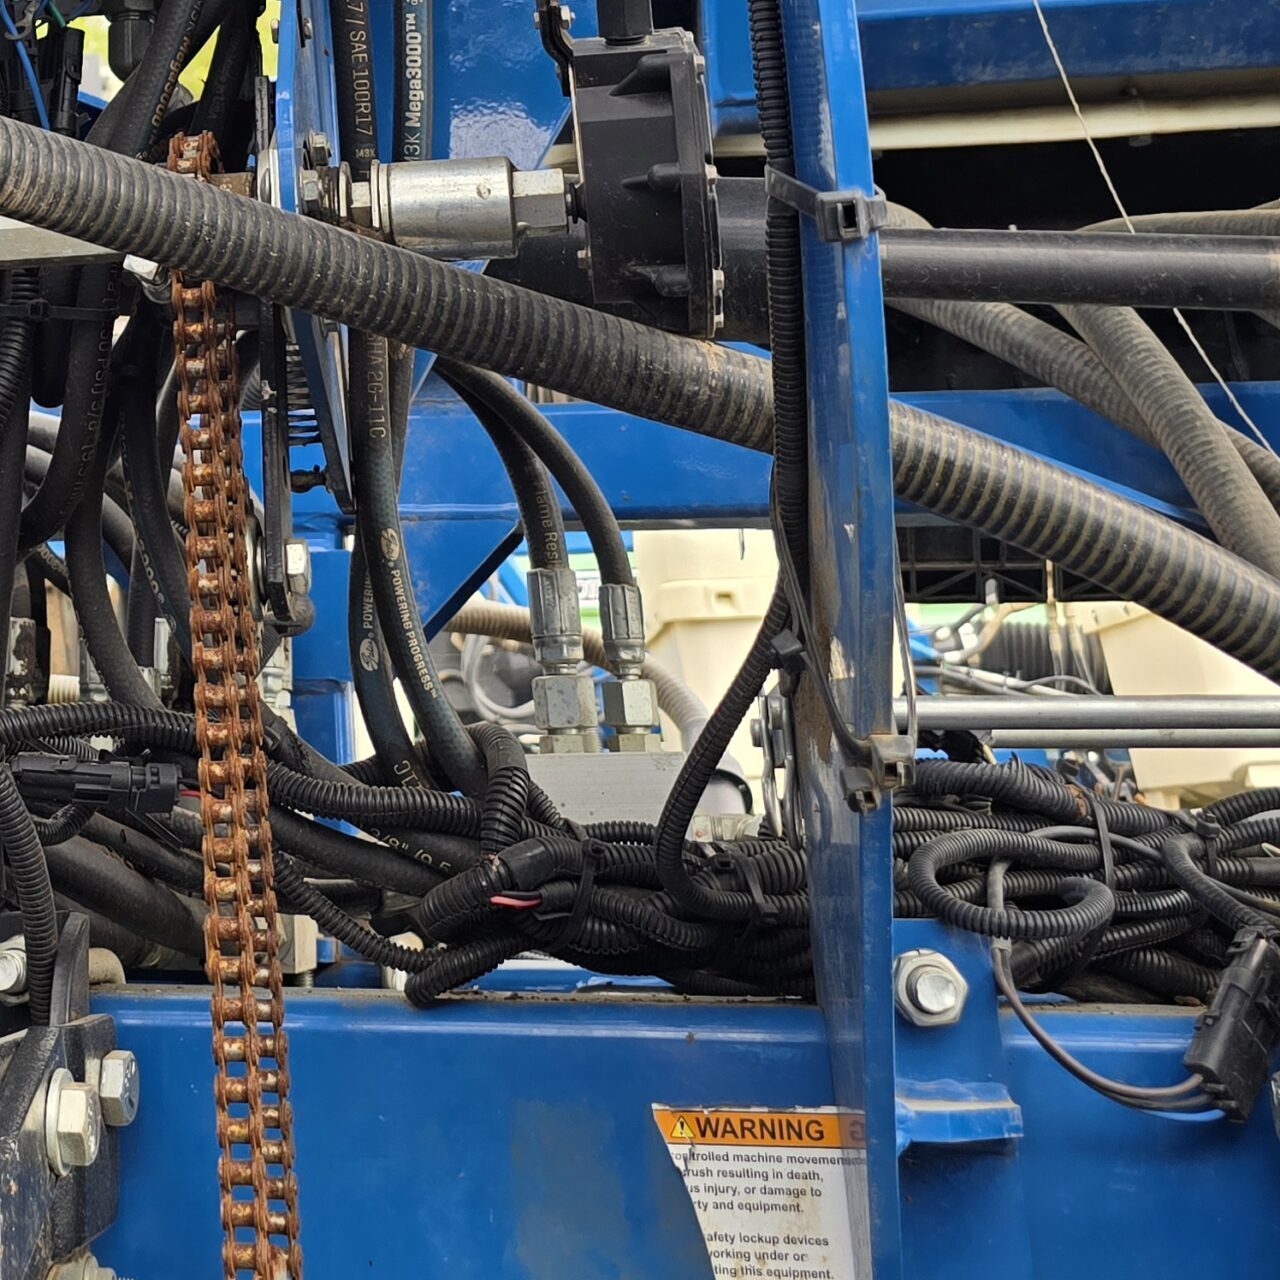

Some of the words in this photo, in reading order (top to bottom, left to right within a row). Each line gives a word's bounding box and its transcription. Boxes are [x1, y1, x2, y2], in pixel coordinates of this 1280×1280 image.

[350, 30, 368, 63] SAE
[352, 69, 373, 136] 100R17
[368, 371, 386, 438] 2G-11C
[390, 569, 412, 630] POWERING
[695, 1117, 825, 1141] WARNING
[733, 1152, 783, 1163] machine
[717, 1168, 769, 1181] resulting
[772, 1169, 783, 1179] in
[787, 1170, 824, 1182] death,
[704, 1183, 740, 1196] injury,
[744, 1186, 756, 1195] or
[760, 1185, 806, 1198] damage
[811, 1187, 822, 1197] to
[712, 1201, 734, 1210] and
[737, 1202, 804, 1213] equipment.
[739, 1232, 780, 1246] lockup
[783, 1234, 829, 1246] devices
[755, 1249, 789, 1261] under
[792, 1253, 806, 1261] or
[741, 1265, 763, 1276] this
[766, 1267, 835, 1280] equipment.
